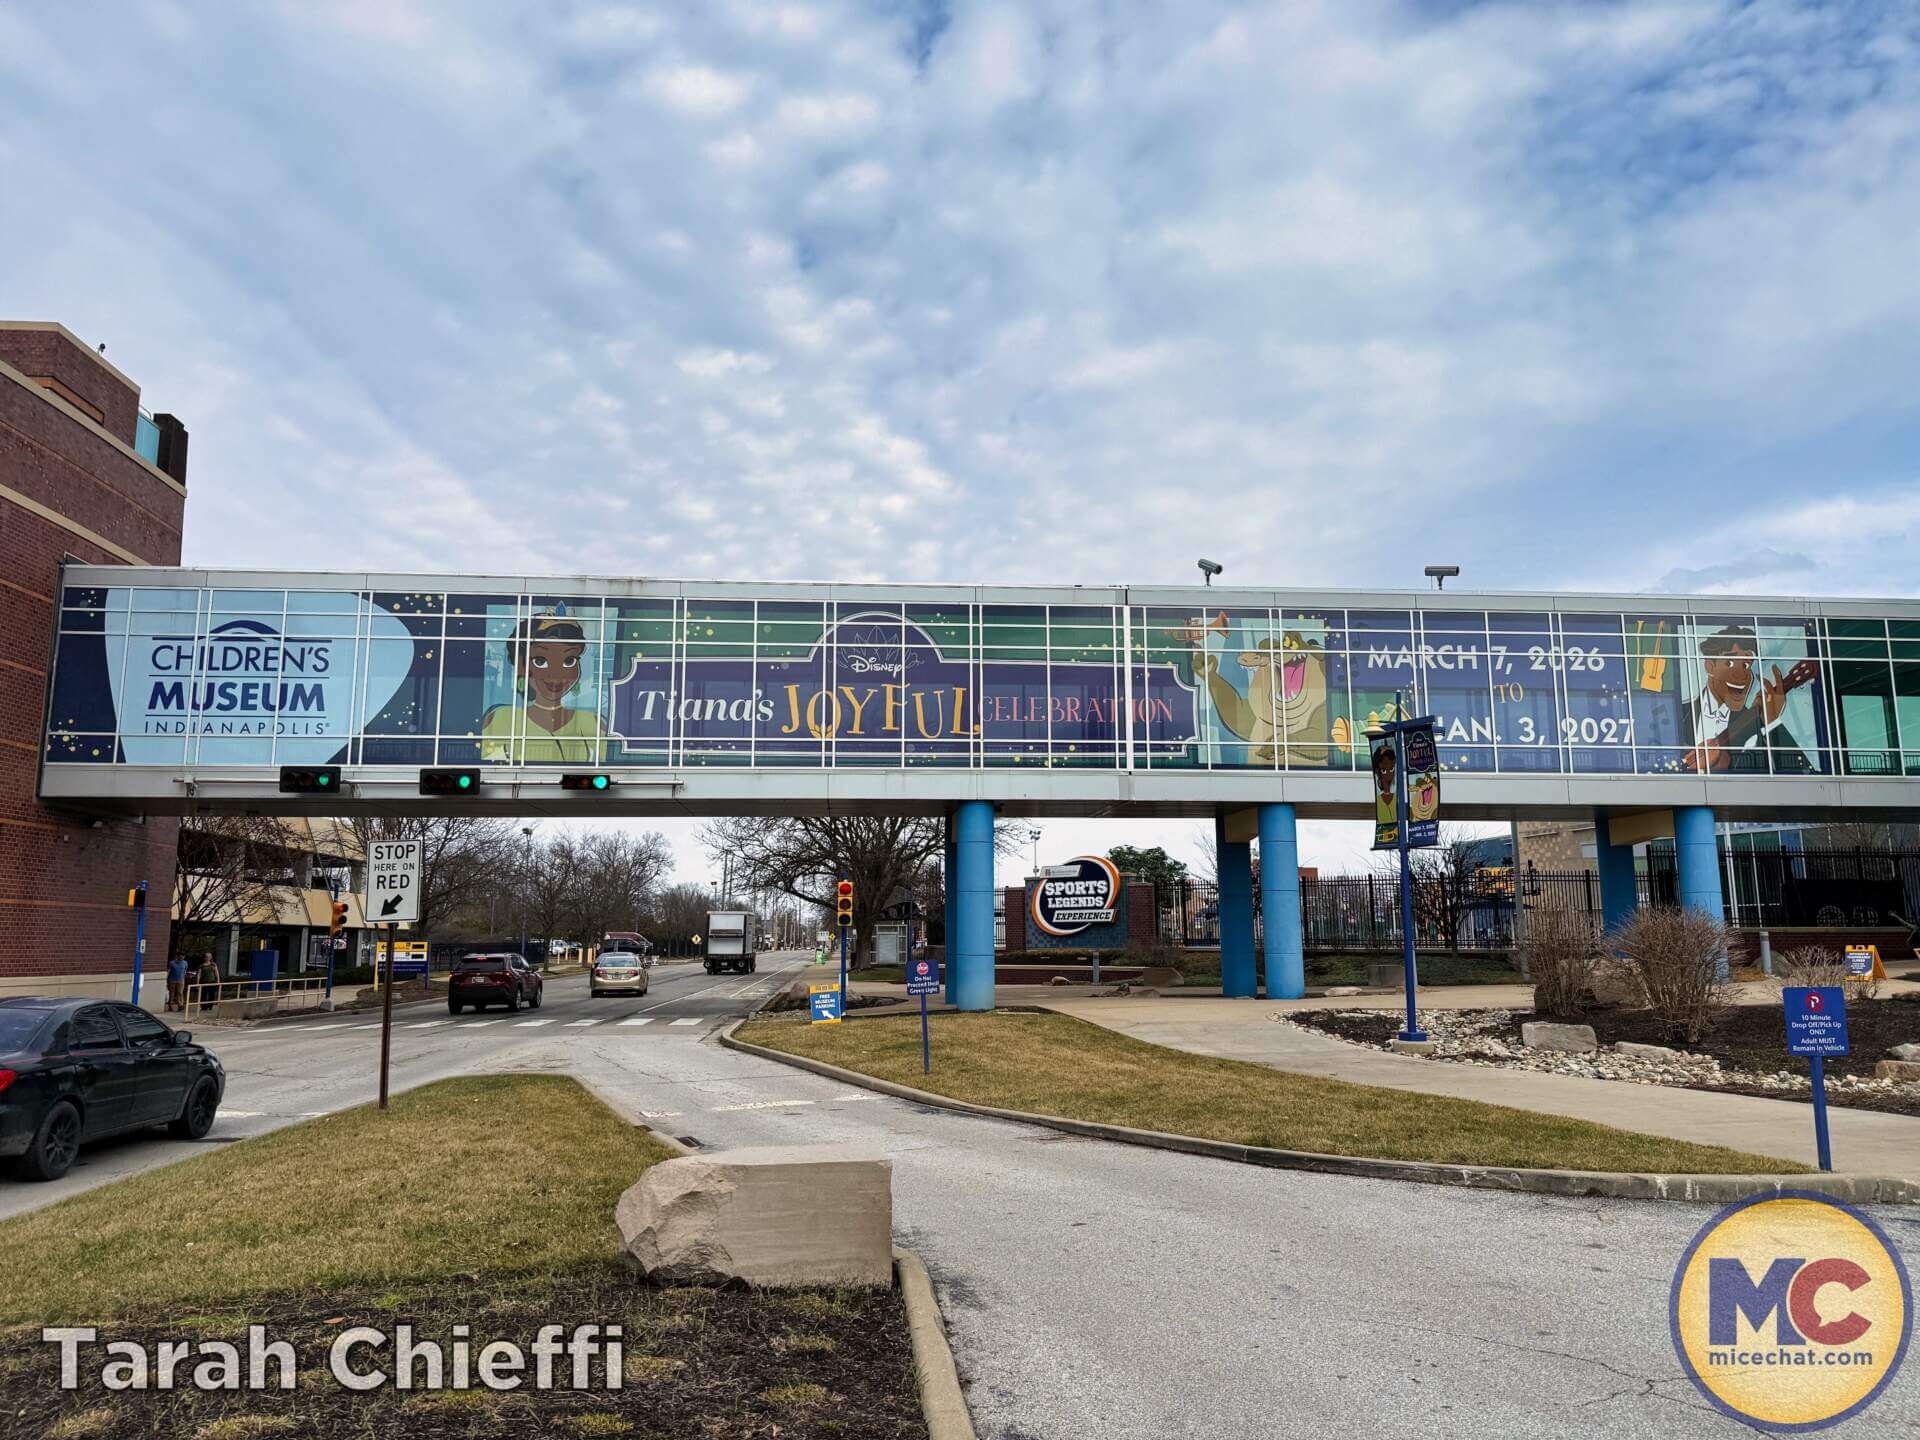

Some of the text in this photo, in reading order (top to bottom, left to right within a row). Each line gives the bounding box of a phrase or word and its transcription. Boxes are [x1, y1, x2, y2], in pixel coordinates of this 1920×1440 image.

[151, 645, 330, 673] CHILDREN'S
[847, 654, 904, 679] Disney
[1367, 644, 1606, 675] MARCH 7, 2026
[147, 681, 325, 712] MUSEUM
[1493, 682, 1524, 704] TO
[637, 683, 1175, 740] Tiana's JOYFUL CELEBRATION
[1518, 716, 1546, 746] 3,
[1561, 717, 1635, 744] 2027
[374, 844, 416, 860] STOP
[374, 862, 415, 871] HERE ON
[376, 874, 410, 890] RED
[1045, 880, 1108, 896] SPORTS
[1047, 896, 1104, 909] LEGENDS
[1055, 911, 1112, 921] EXPERIENCE
[1791, 1021, 1807, 1029] Drop
[1833, 1022, 1842, 1030] Up
[1824, 1043, 1845, 1051] Vehicle
